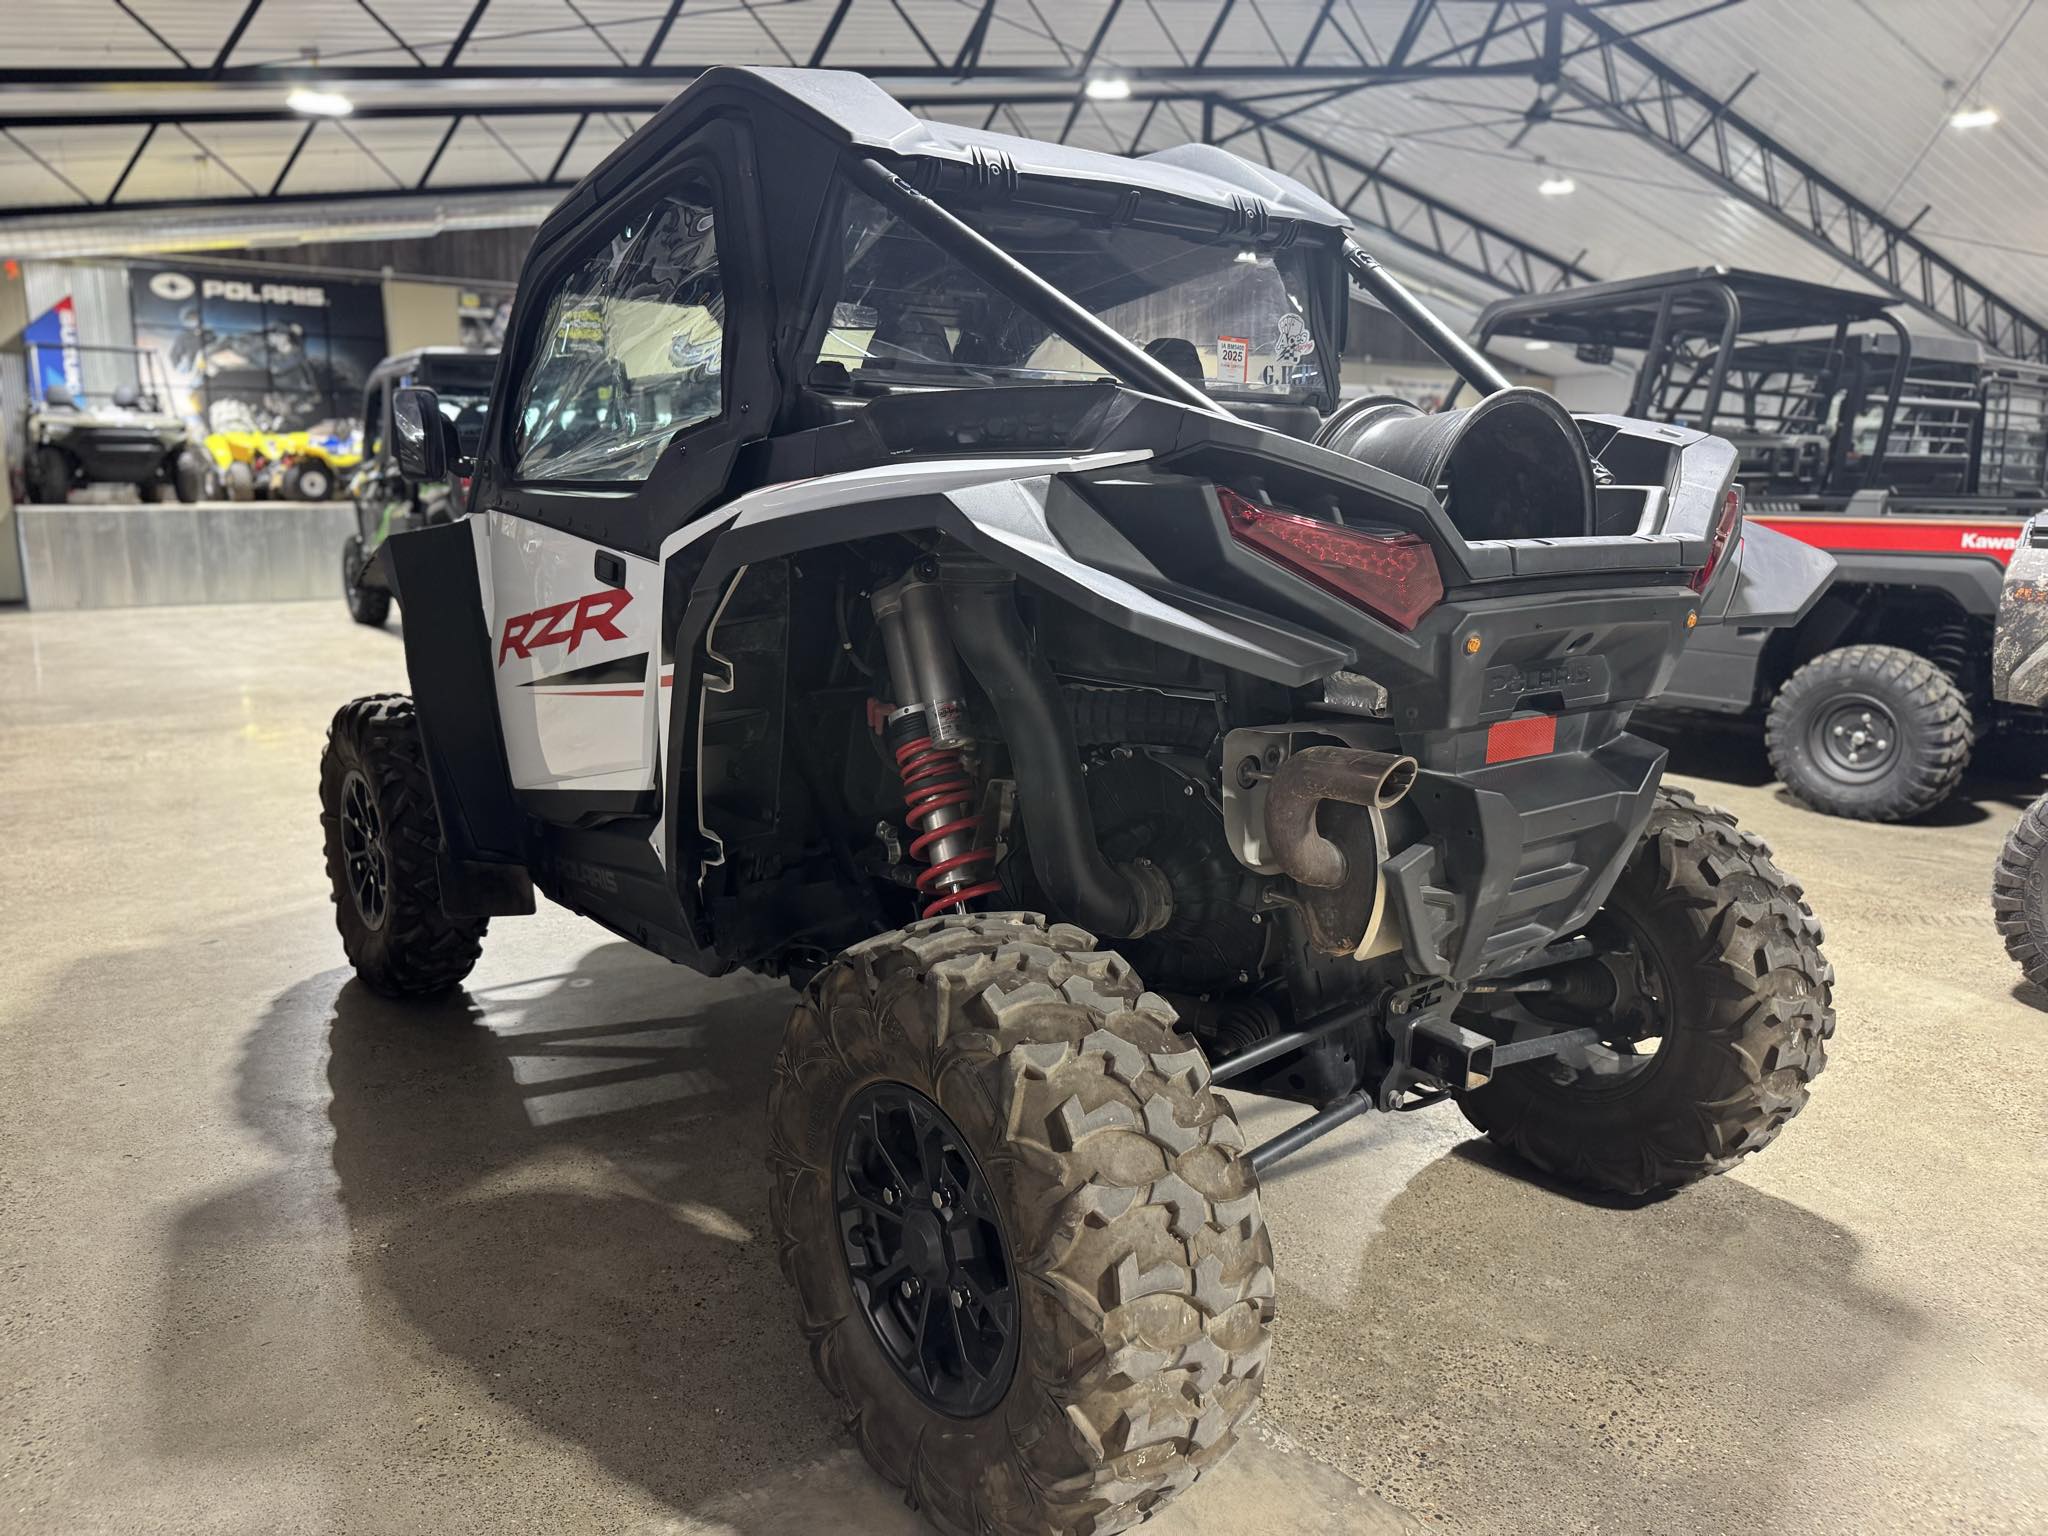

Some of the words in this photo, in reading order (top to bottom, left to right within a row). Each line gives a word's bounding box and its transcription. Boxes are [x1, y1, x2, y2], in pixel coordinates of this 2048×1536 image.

[202, 279, 325, 307] POLARIS
[1277, 331, 1308, 350] Aces
[1222, 349, 1243, 362] 2025
[498, 587, 634, 669] RZR
